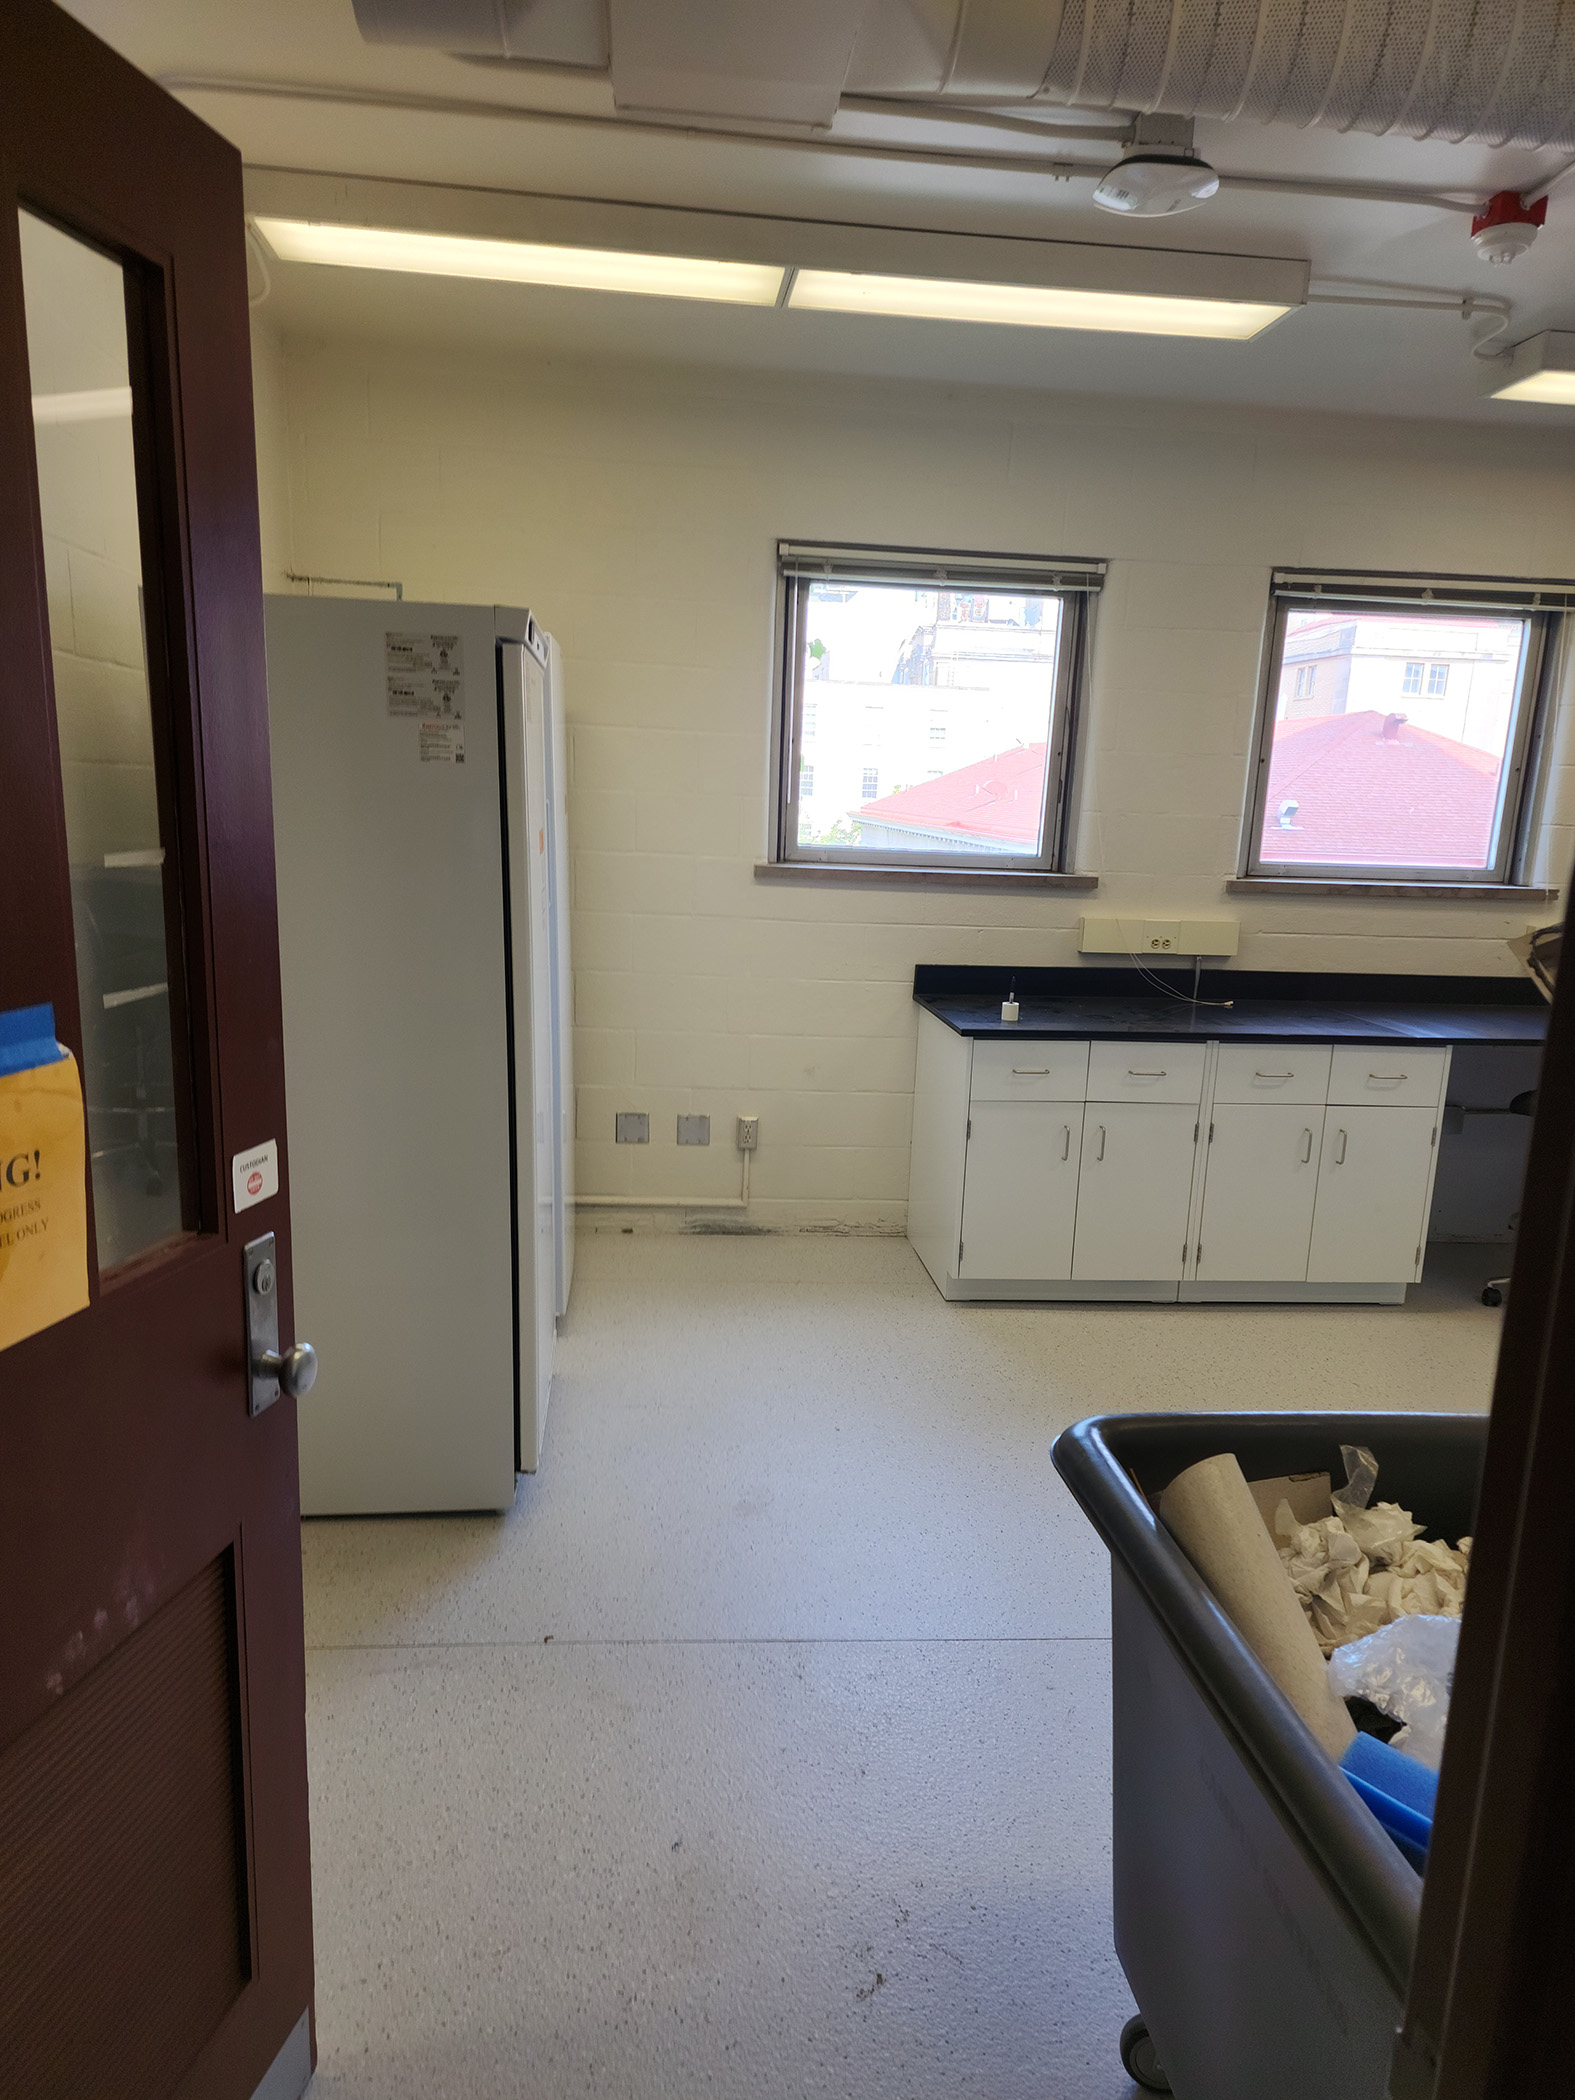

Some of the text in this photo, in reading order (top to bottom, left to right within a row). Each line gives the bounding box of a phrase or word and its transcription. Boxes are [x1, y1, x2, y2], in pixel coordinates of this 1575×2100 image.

[0, 1150, 41, 1191] G!
[239, 1154, 269, 1174] CUSTODIAN
[16, 1216, 49, 1241] ONLY
